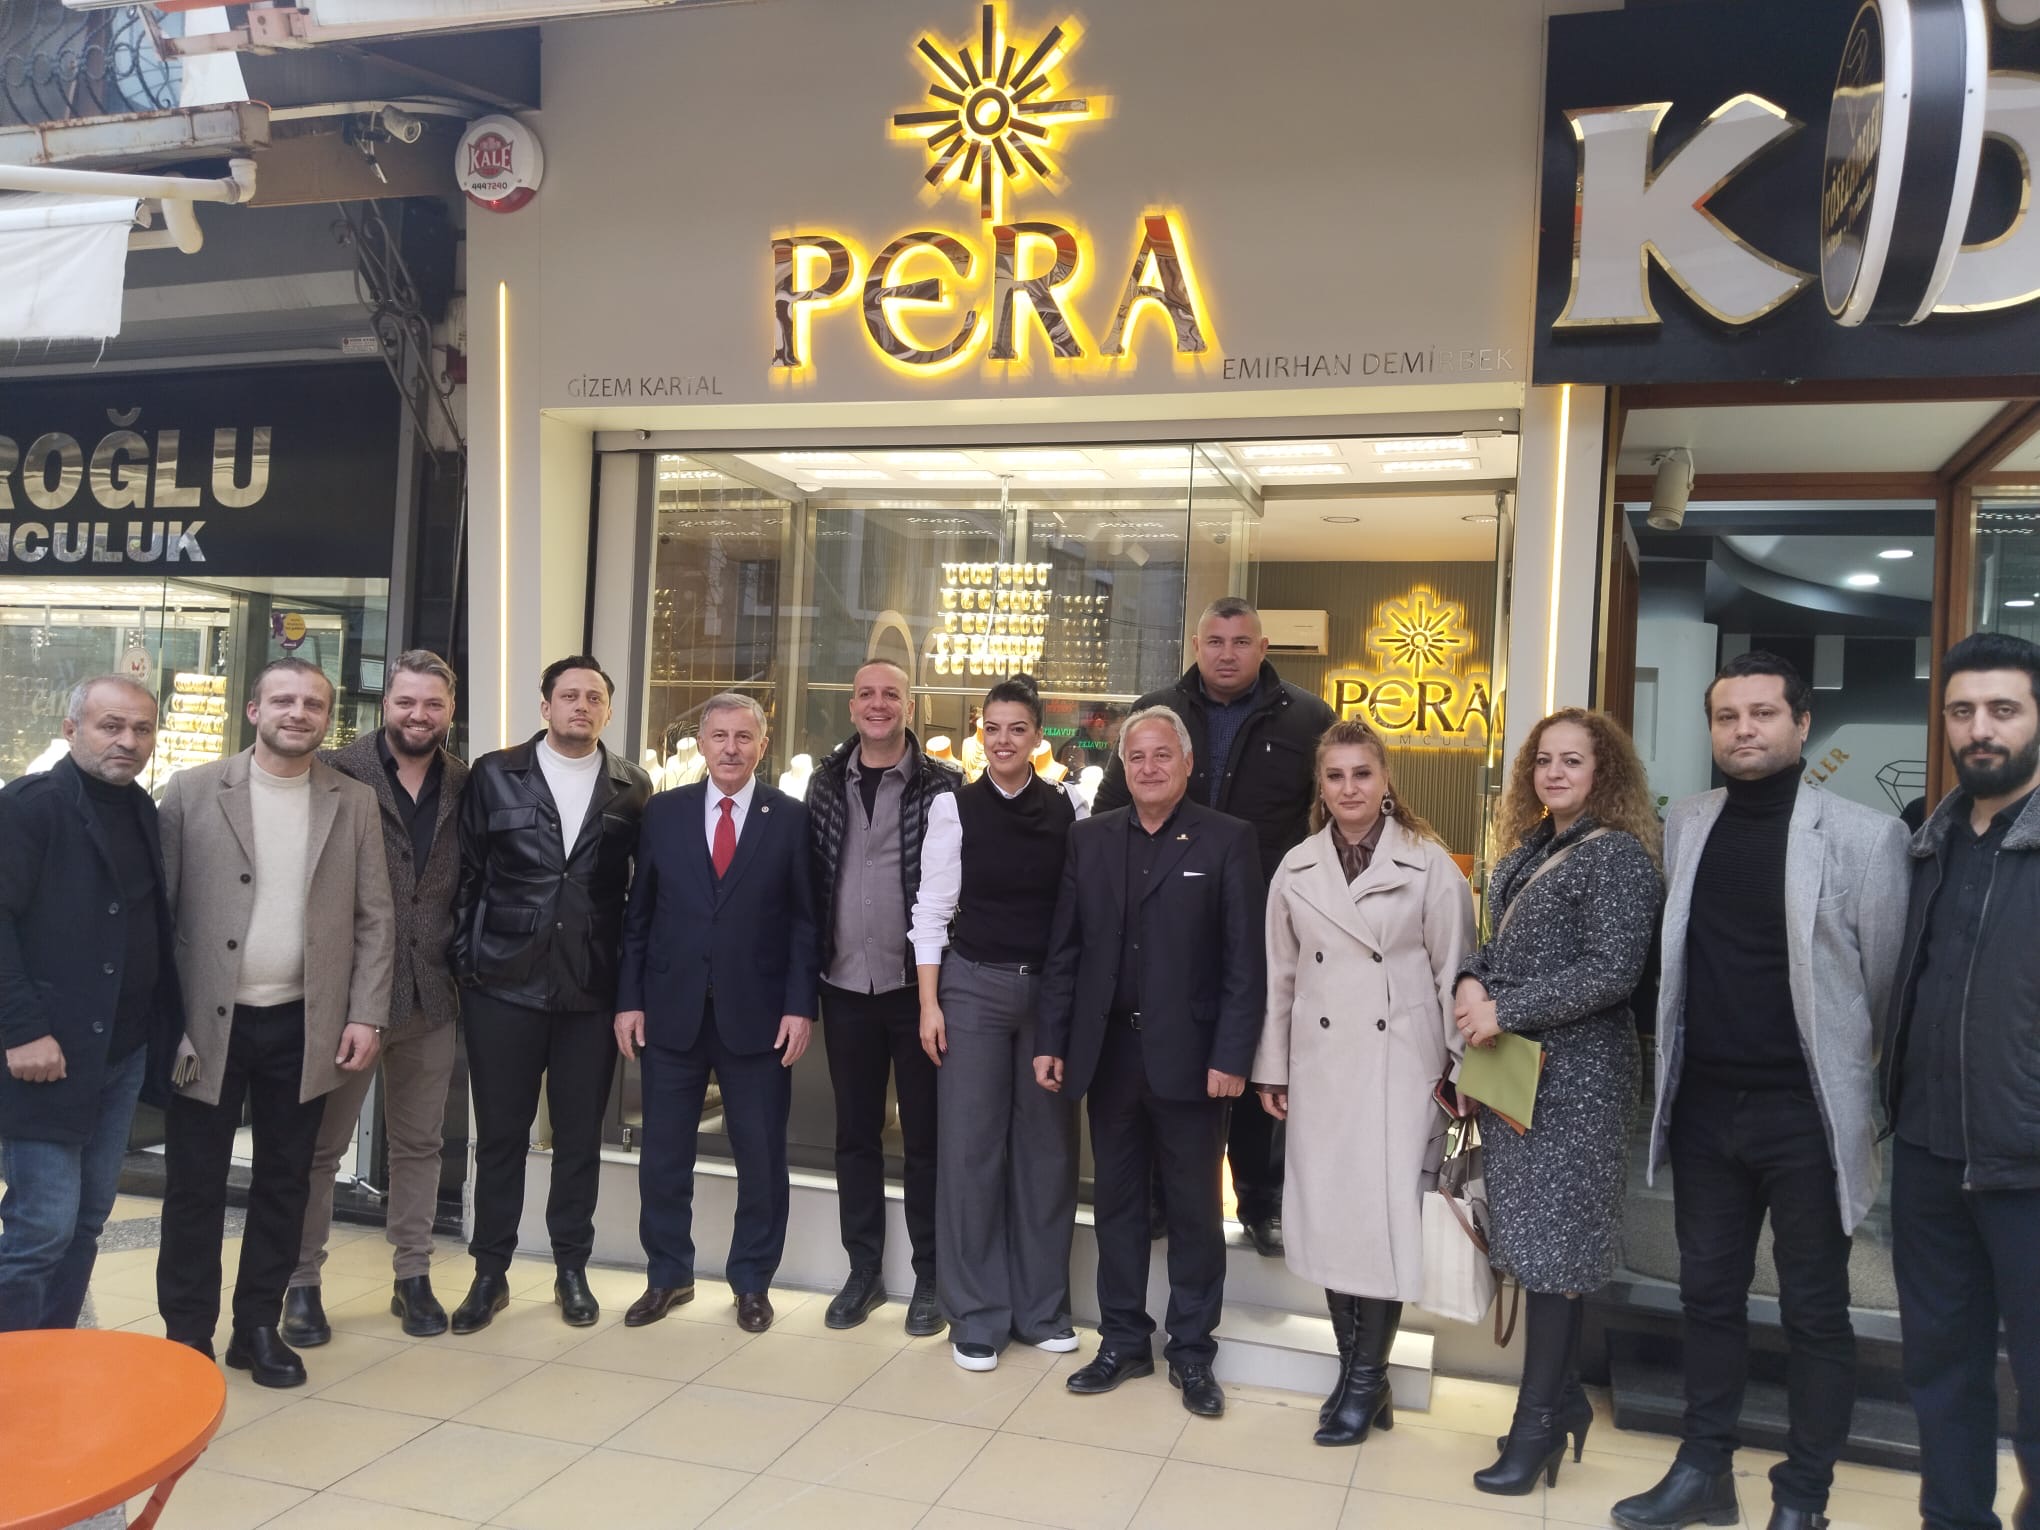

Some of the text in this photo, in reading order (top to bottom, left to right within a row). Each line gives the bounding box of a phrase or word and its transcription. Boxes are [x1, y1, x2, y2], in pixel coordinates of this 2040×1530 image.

[470, 145, 511, 172] KALE
[771, 214, 1208, 368] PERA
[1361, 343, 1514, 375] DEMİRBEK
[567, 373, 723, 398] GİZEM KARTAL
[0, 520, 207, 563] CULUK
[1335, 679, 1492, 732] PERA
